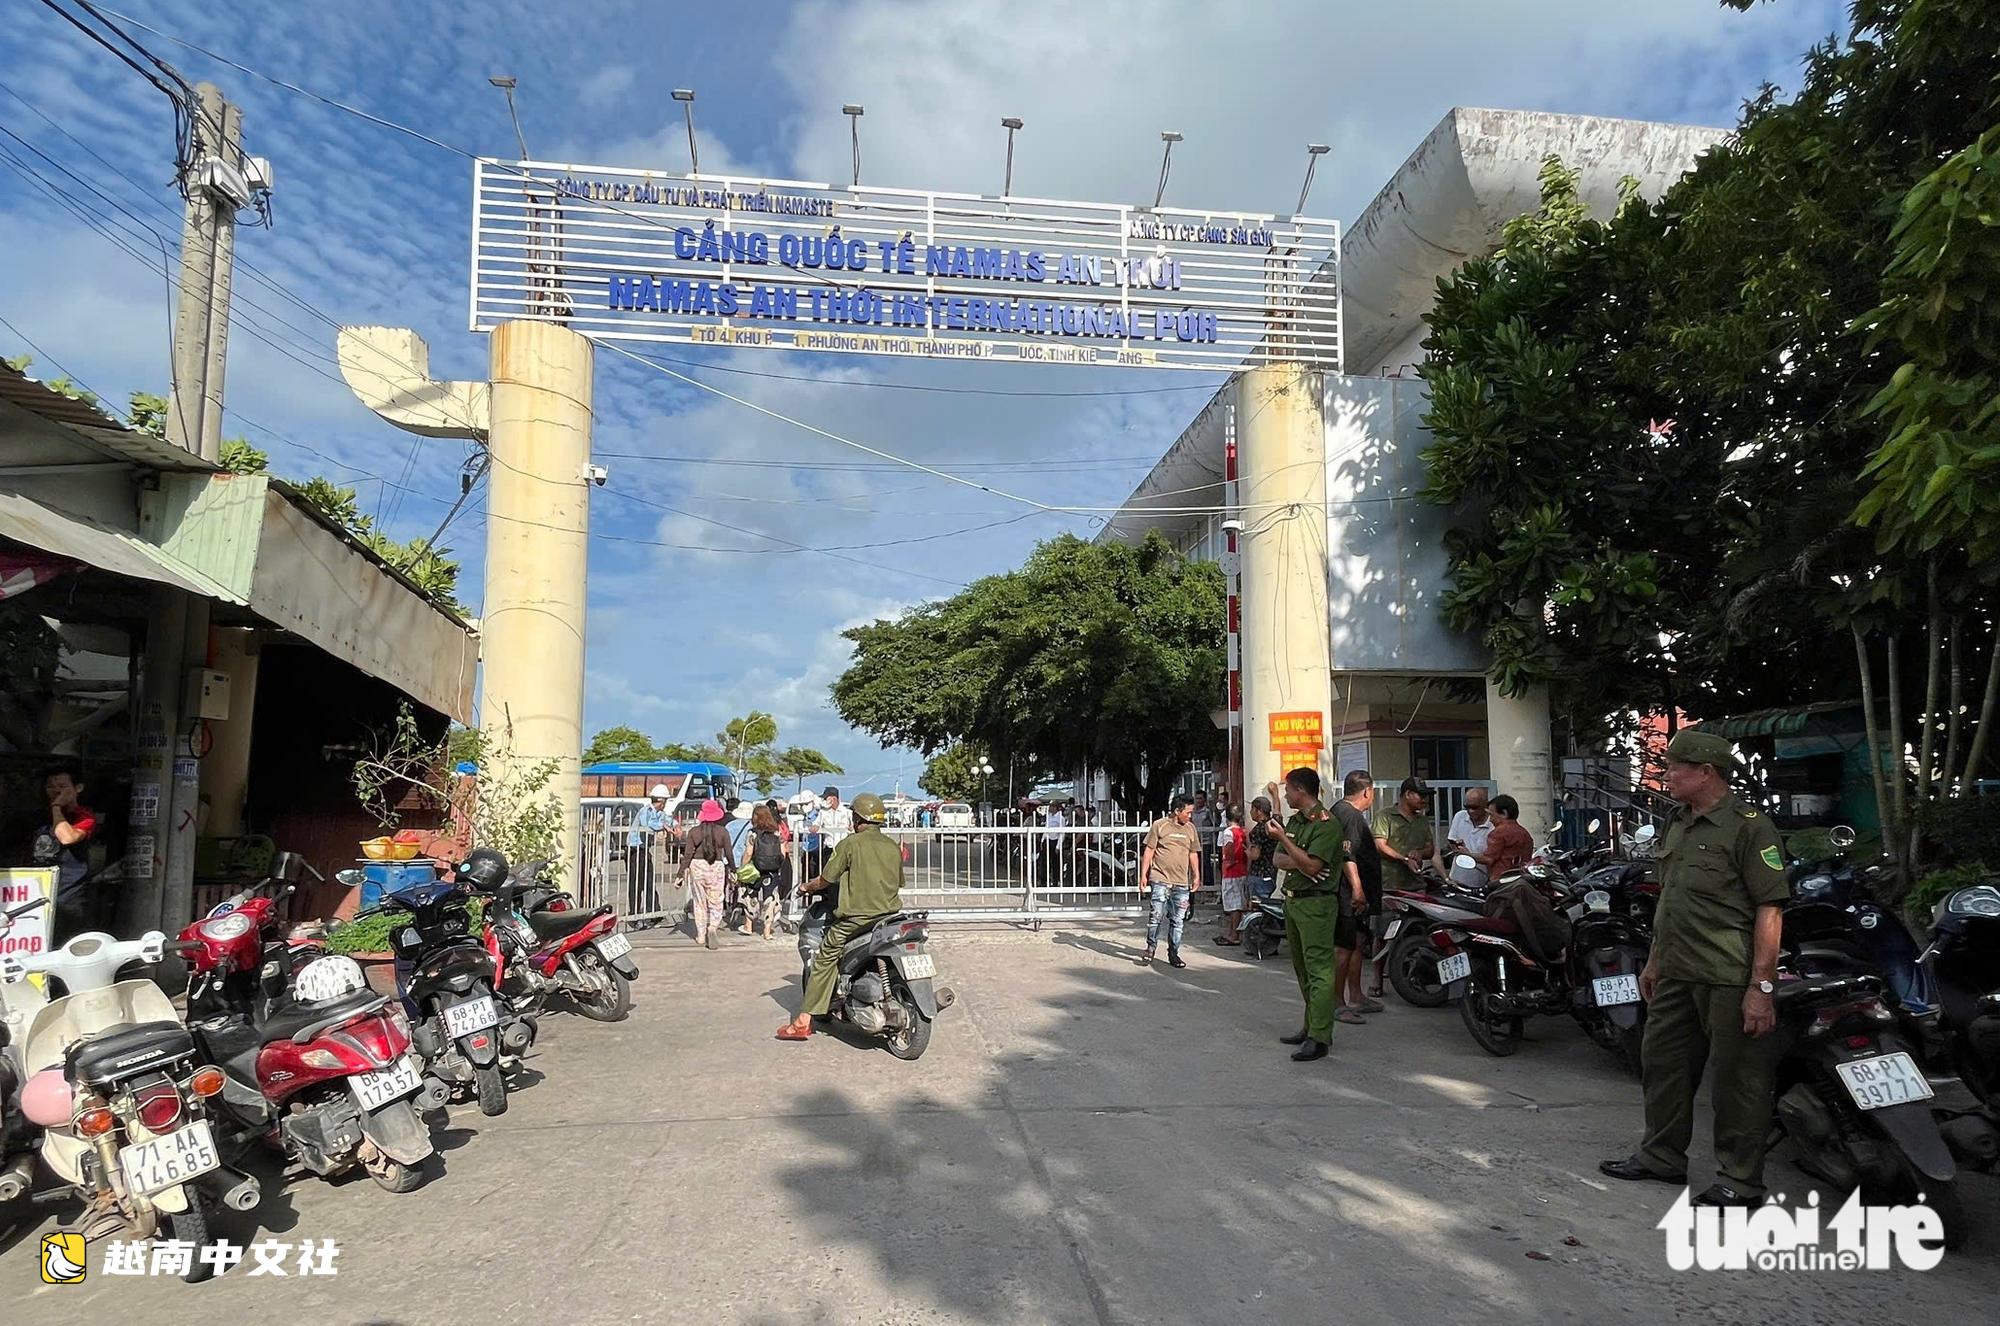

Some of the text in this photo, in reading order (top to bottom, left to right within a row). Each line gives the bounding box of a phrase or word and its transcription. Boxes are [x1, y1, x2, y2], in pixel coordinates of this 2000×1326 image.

[776, 196, 833, 217] NAMASTE
[674, 218, 768, 265] CẢNG
[779, 225, 867, 271] QUỐC
[879, 231, 915, 276] TẾ
[926, 245, 1047, 282] NAMAS
[1057, 254, 1101, 286] AN
[609, 275, 738, 317] NAMAS
[750, 286, 798, 321] AN
[893, 294, 1145, 341] INTERNATIONAL
[735, 331, 761, 345] KHU
[862, 338, 878, 352] AN
[1600, 978, 1630, 992] 68-P1
[453, 1001, 486, 1021] 68-P1
[116, 1050, 166, 1068] HONDA
[1850, 1056, 1906, 1083] 68-P1
[363, 1071, 416, 1106] 179.57
[1856, 1076, 1927, 1106] 397.71
[136, 1129, 200, 1168] 71-AA
[135, 1147, 213, 1193] 146.85
